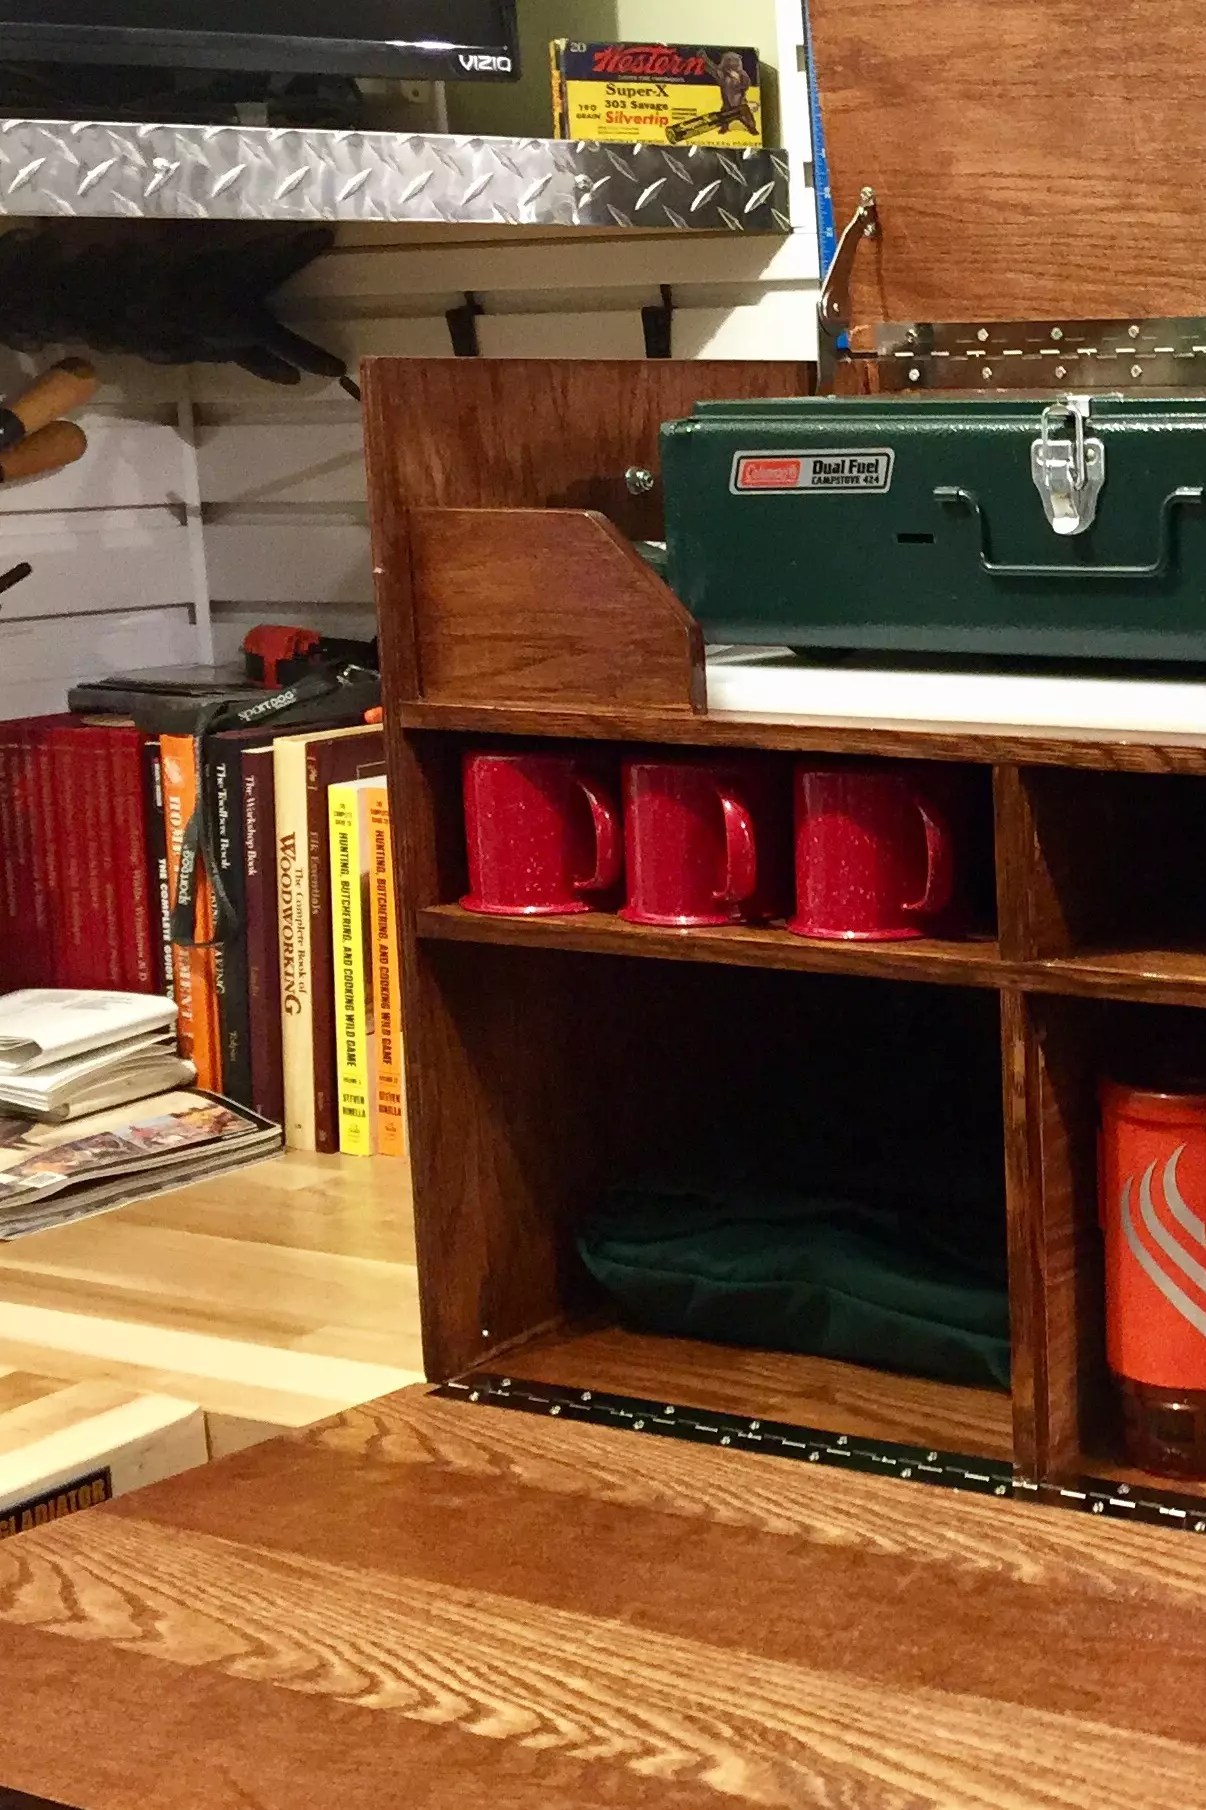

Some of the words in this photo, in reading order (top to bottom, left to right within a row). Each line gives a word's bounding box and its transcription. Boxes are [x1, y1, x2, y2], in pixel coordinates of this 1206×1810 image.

[570, 42, 587, 53] 20
[592, 44, 706, 76] Western
[459, 54, 512, 73] VIZIO
[606, 83, 669, 98] Super-X
[605, 99, 629, 109] 303
[631, 100, 669, 111] Savage
[605, 111, 669, 127] Silvertip
[812, 459, 846, 475] Dual
[848, 458, 880, 474] Fuel
[811, 475, 861, 486] CAMPSTOVE
[863, 474, 880, 484] 424
[220, 838, 231, 870] Book
[247, 851, 258, 876] Book
[158, 858, 168, 880] THE
[159, 883, 172, 942] COMPLETE
[280, 832, 302, 1016] WOODWORKING
[163, 944, 174, 980] GUIDE
[343, 946, 353, 966] AND
[379, 944, 389, 964] AND
[344, 968, 355, 1011] COOKING
[380, 966, 391, 1010] COOKING
[345, 1012, 356, 1038] WILD
[381, 1011, 392, 1036] WILD
[346, 1038, 357, 1068] GAME
[382, 1036, 393, 1066] GAME
